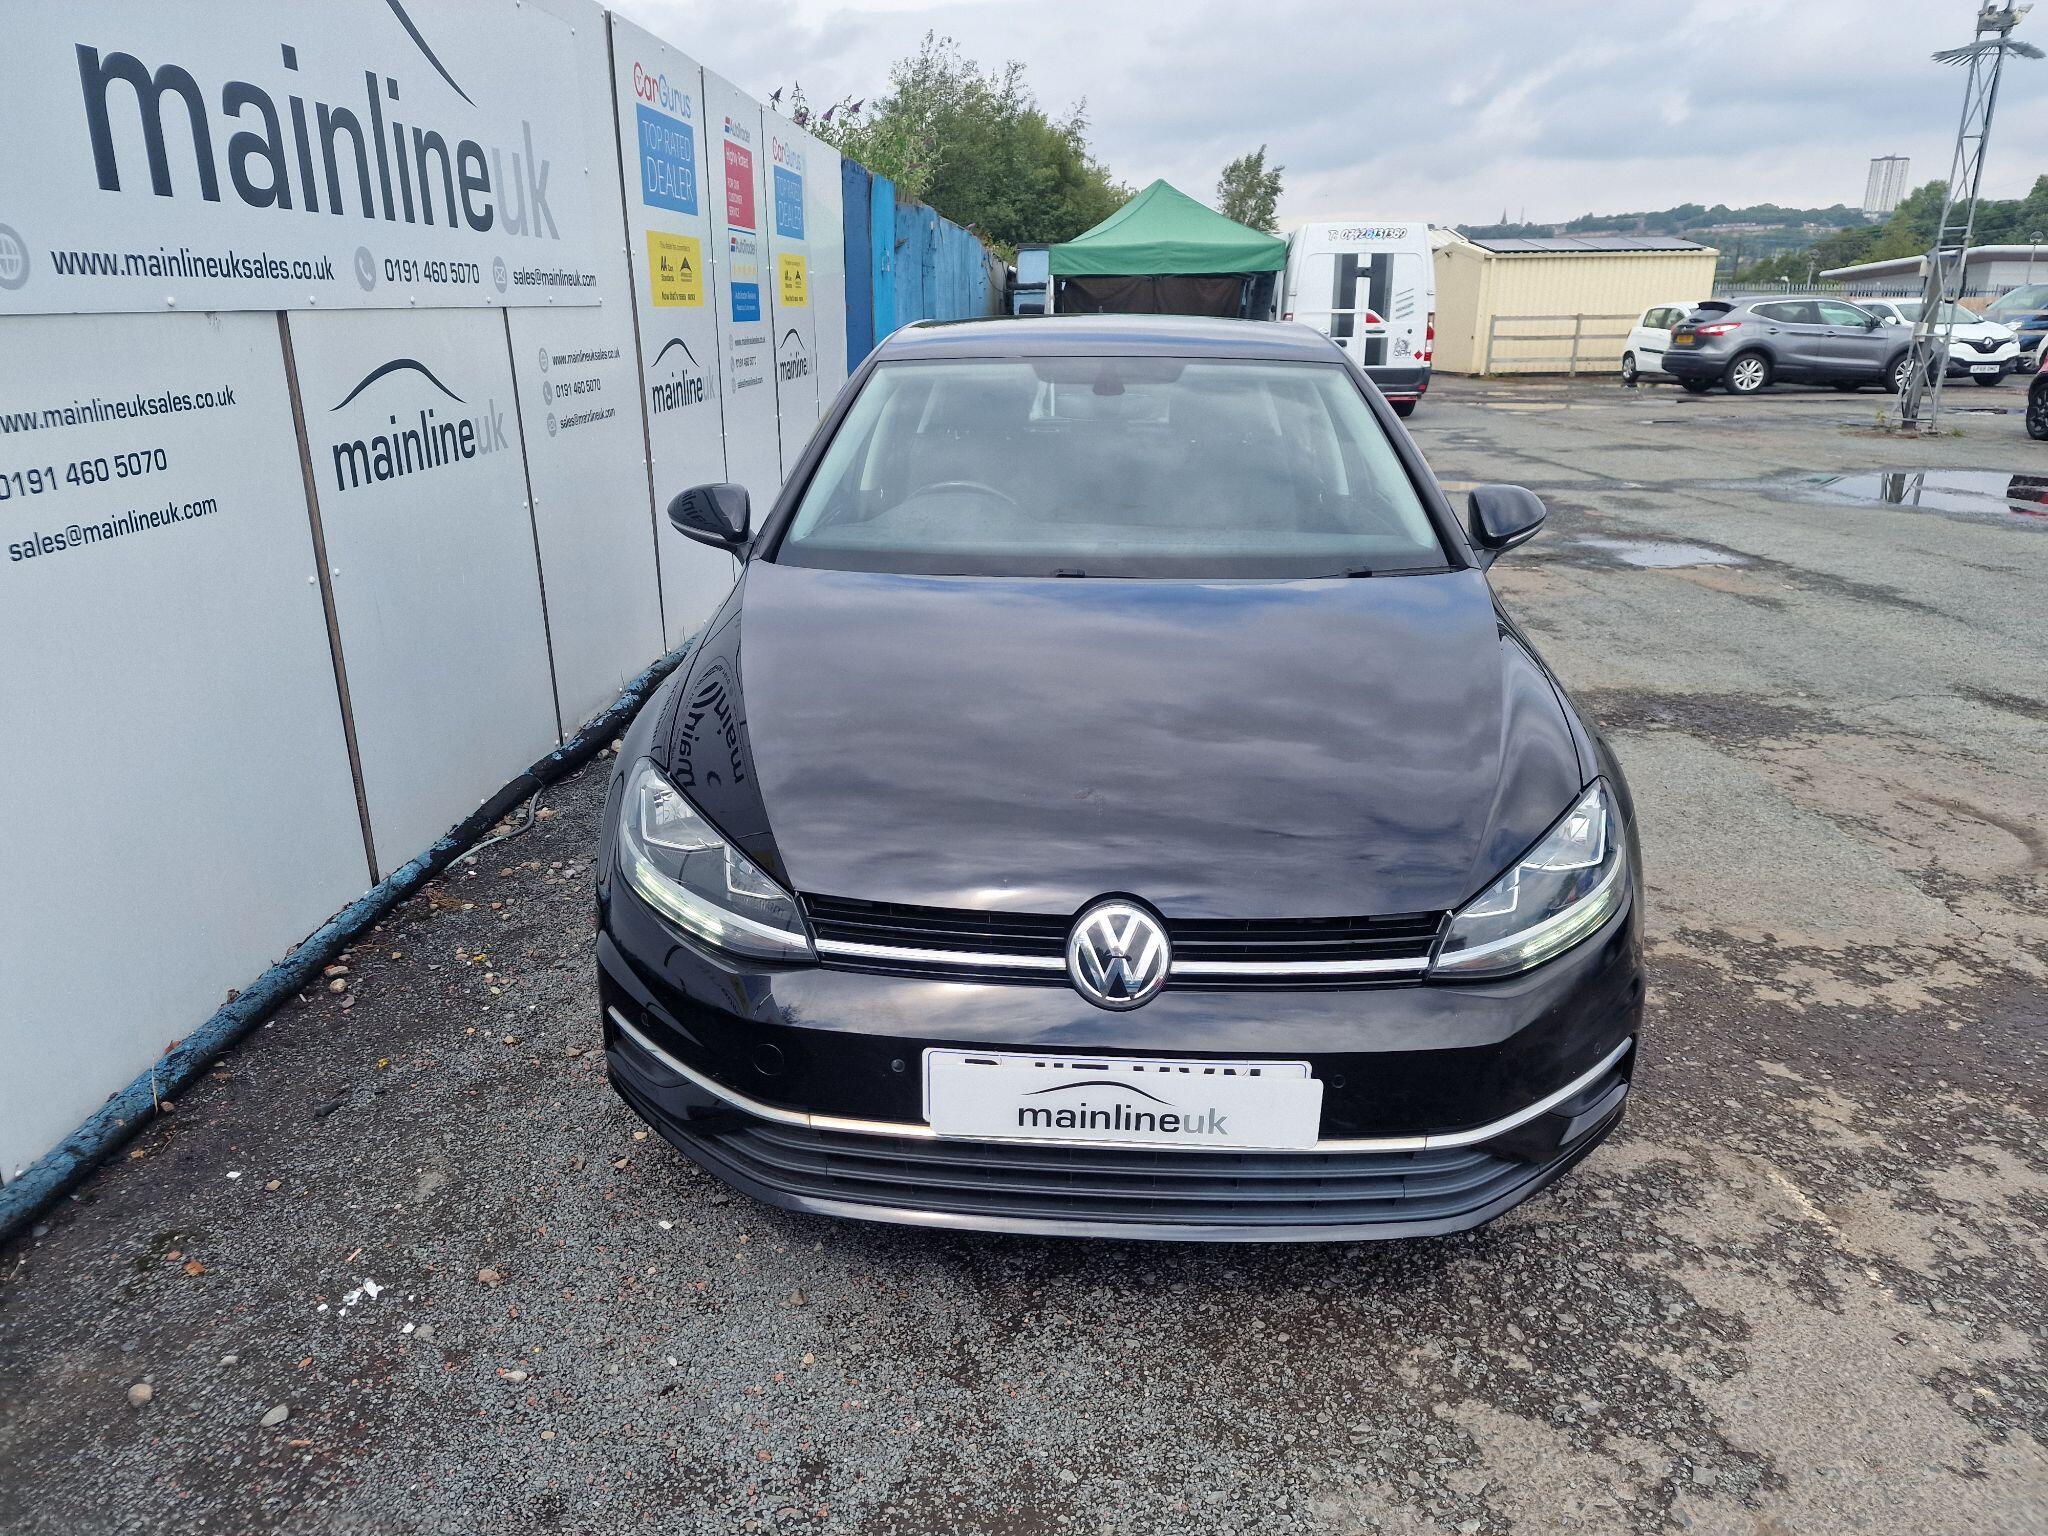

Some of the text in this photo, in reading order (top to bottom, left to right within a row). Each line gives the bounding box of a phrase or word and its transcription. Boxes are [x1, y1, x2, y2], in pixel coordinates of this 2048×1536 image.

[633, 62, 691, 119] CarGurus
[75, 43, 560, 240] mainlineuk
[642, 120, 692, 161] TOP RATED
[646, 156, 694, 202] DEALER
[50, 246, 335, 280] www.mainlineuksales.co.uk
[384, 258, 480, 284] 0191 460 5070
[513, 266, 597, 287] sales@mainlineuk.com
[555, 378, 601, 398] 0191 460 5070
[652, 365, 716, 414] mainlineuk
[332, 398, 509, 491] mainlineuk
[66, 457, 110, 487] 460
[114, 448, 168, 478] 5070
[8, 498, 217, 562] sales@mainlineuk.com
[1018, 1102, 1229, 1135] mainlineuk
